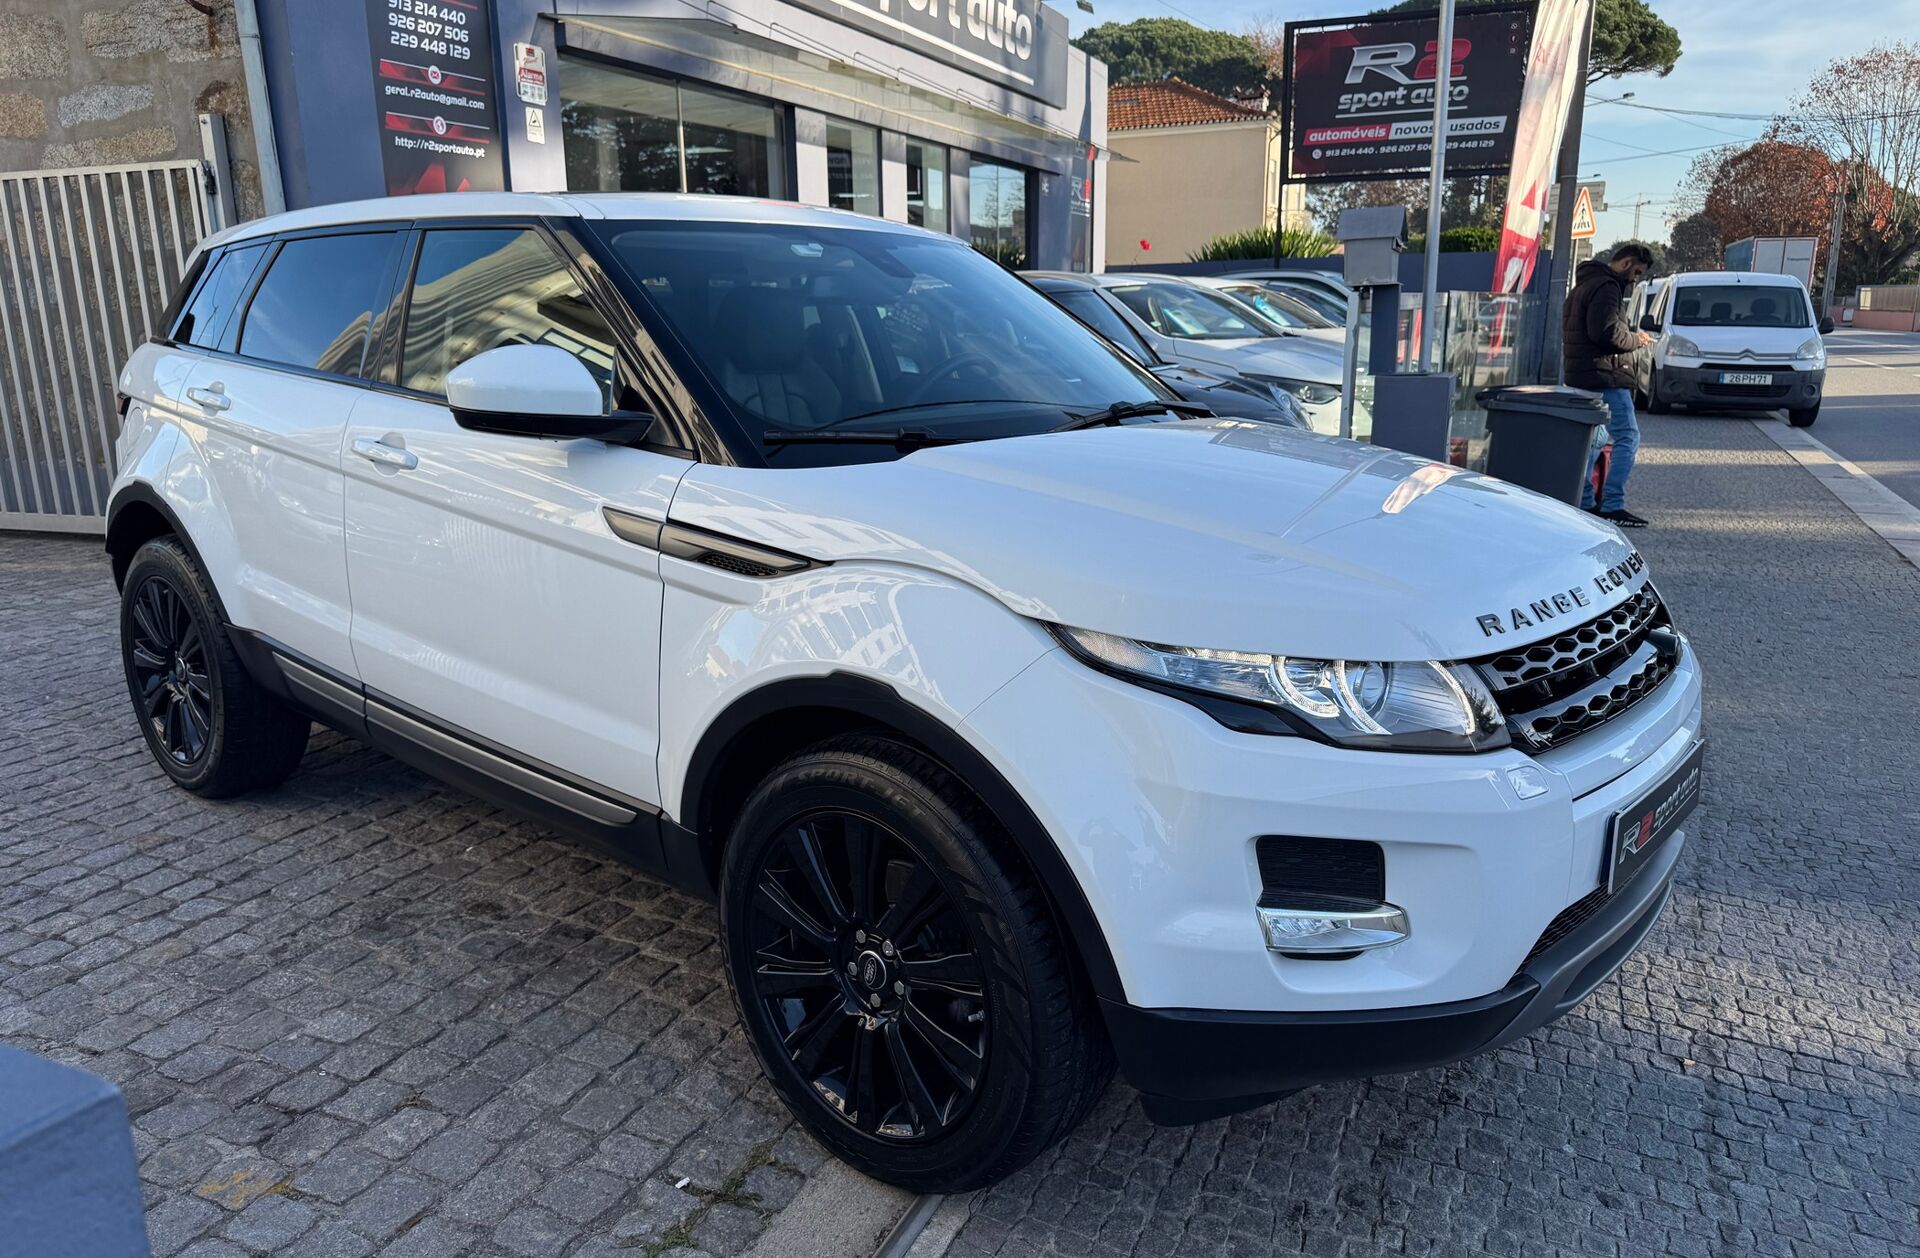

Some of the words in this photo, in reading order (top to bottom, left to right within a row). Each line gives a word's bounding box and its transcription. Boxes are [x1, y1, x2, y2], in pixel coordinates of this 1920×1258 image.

[388, 0, 412, 12] 913
[414, 0, 438, 18] 214
[439, 8, 466, 25] 440
[388, 12, 416, 31] 926
[417, 18, 442, 36] 207
[444, 25, 469, 43] 506
[967, 0, 1033, 61] auto
[390, 30, 418, 49] 229
[420, 38, 447, 56] 448
[449, 43, 471, 60] 129
[1344, 38, 1472, 85] R2
[385, 85, 485, 110] geral.r2auto@gmail.com
[1337, 86, 1408, 113] sport
[1309, 126, 1386, 142] automóveis
[1450, 120, 1501, 132] usados
[394, 135, 486, 158] http://r2sportauto.pt
[1325, 149, 1340, 158] 913
[1341, 148, 1355, 157] 214
[1356, 147, 1374, 155] 440
[1380, 145, 1397, 154] 926
[1398, 144, 1416, 153] 207
[1459, 140, 1478, 149] 448
[1478, 139, 1495, 148] 129
[1476, 586, 1591, 637] RANGE
[1619, 810, 1655, 865] R2
